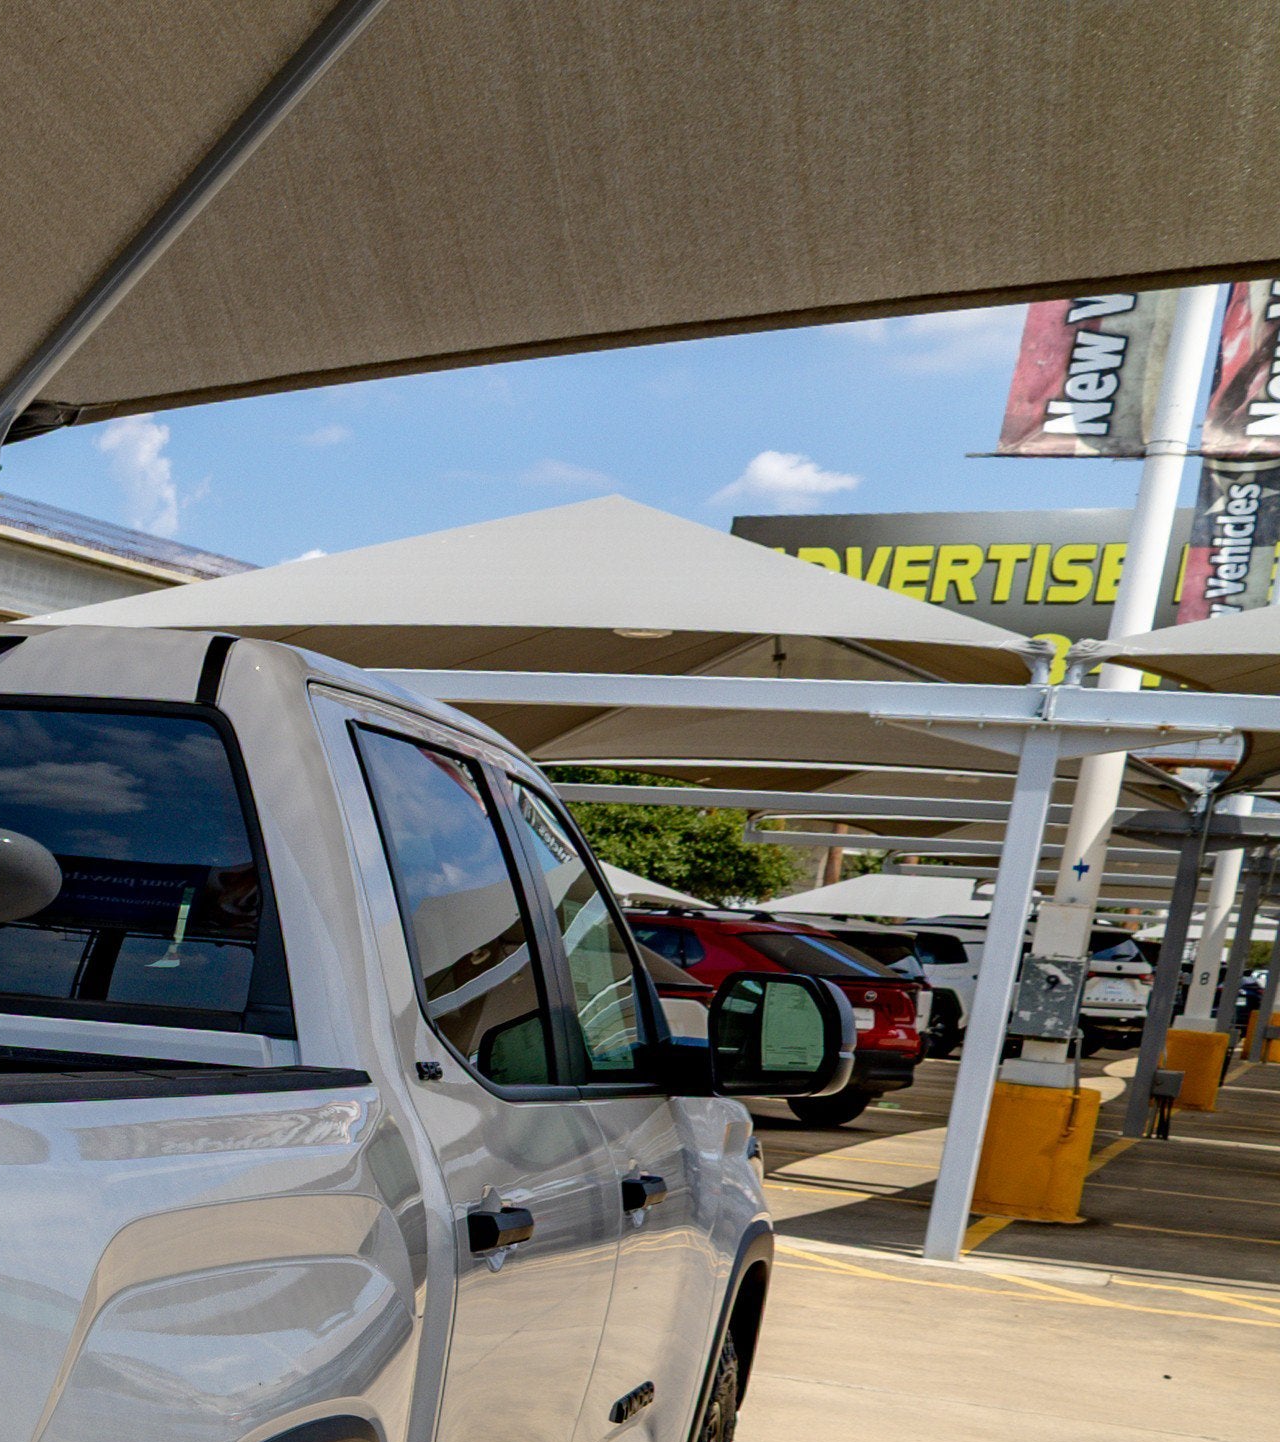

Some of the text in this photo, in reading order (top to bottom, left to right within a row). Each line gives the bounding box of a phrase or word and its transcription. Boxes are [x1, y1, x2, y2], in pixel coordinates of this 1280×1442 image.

[1043, 330, 1128, 436] New
[773, 543, 1128, 603] VERTISE
[1205, 484, 1261, 599] Vehicles
[1199, 971, 1210, 986] 8
